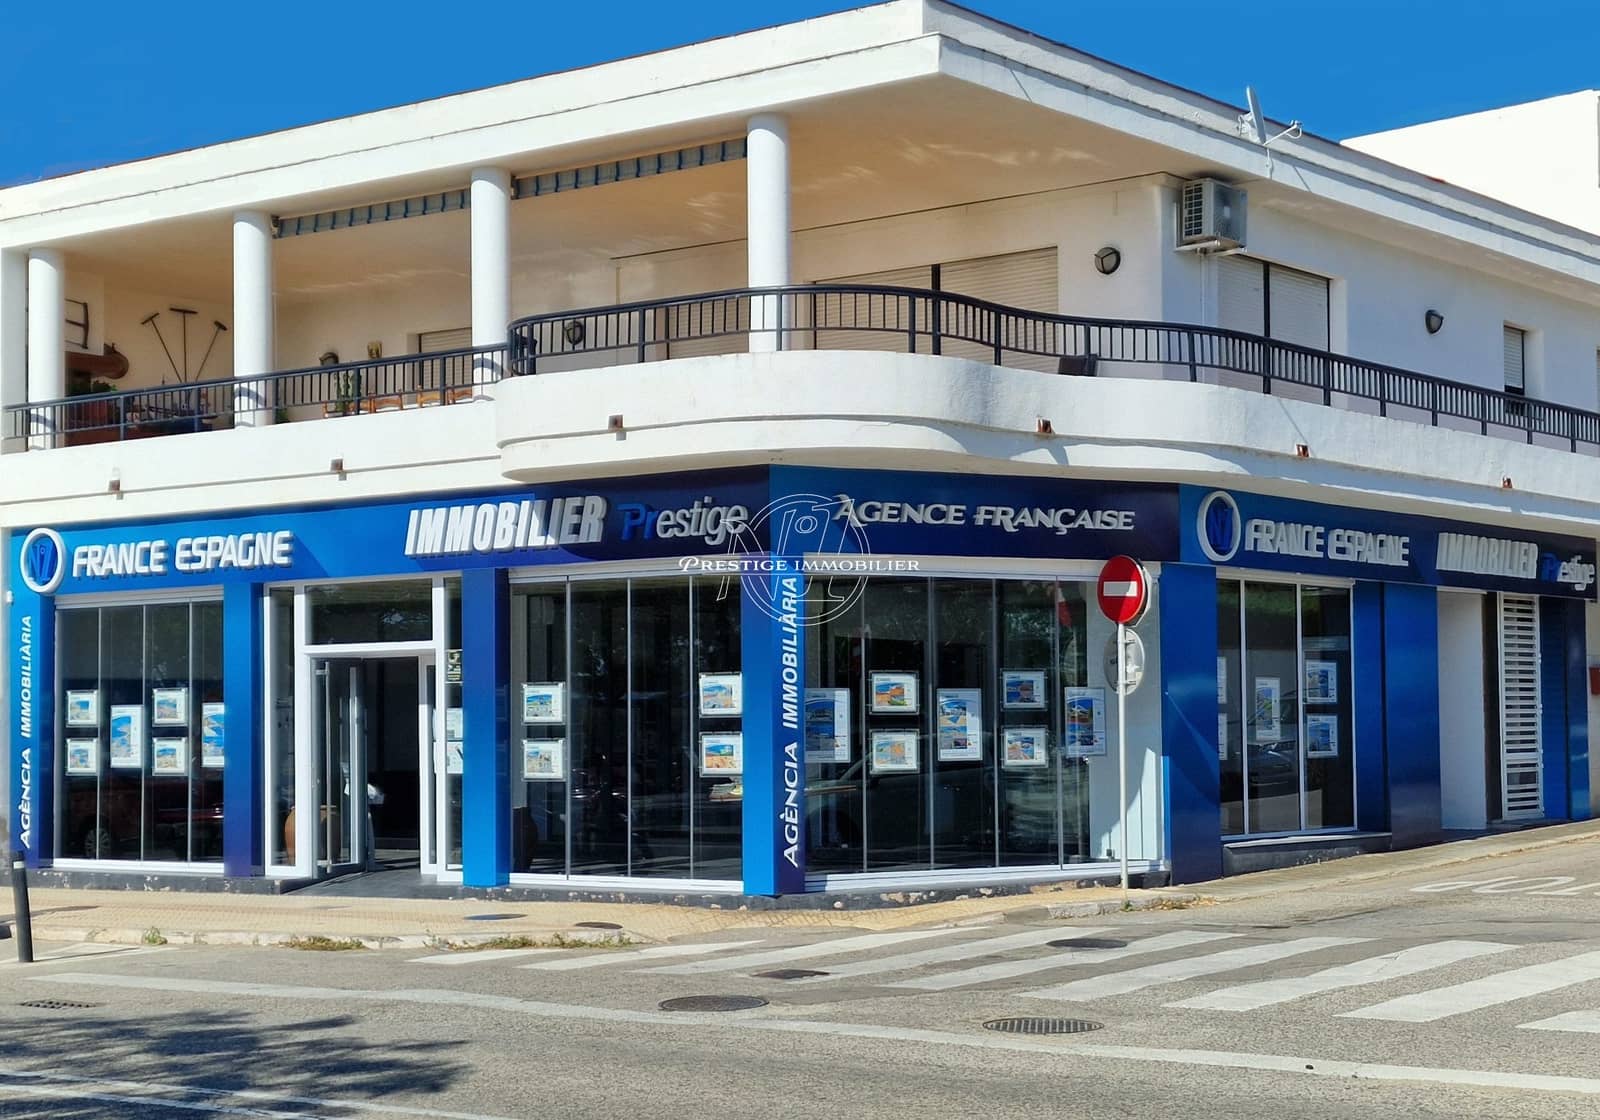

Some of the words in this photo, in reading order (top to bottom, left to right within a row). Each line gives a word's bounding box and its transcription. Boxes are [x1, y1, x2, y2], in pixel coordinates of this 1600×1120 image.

[405, 496, 605, 556] IMMOBILIER
[617, 497, 748, 545] Prestige
[832, 494, 966, 527] AGENCE
[973, 503, 1135, 535] FRANÇAISE
[1245, 519, 1324, 558] FRANCE
[1328, 529, 1409, 566] ESPAGNE
[73, 540, 167, 577] FRANCE
[175, 530, 293, 570] ESPAGNE
[1436, 532, 1538, 579] IMMOBILIER
[1542, 553, 1595, 591] Prestige
[20, 616, 32, 738] IMMOBILIÀRIA
[18, 748, 31, 849] AGÈNCIA
[780, 742, 798, 868] AGÈNCIA
